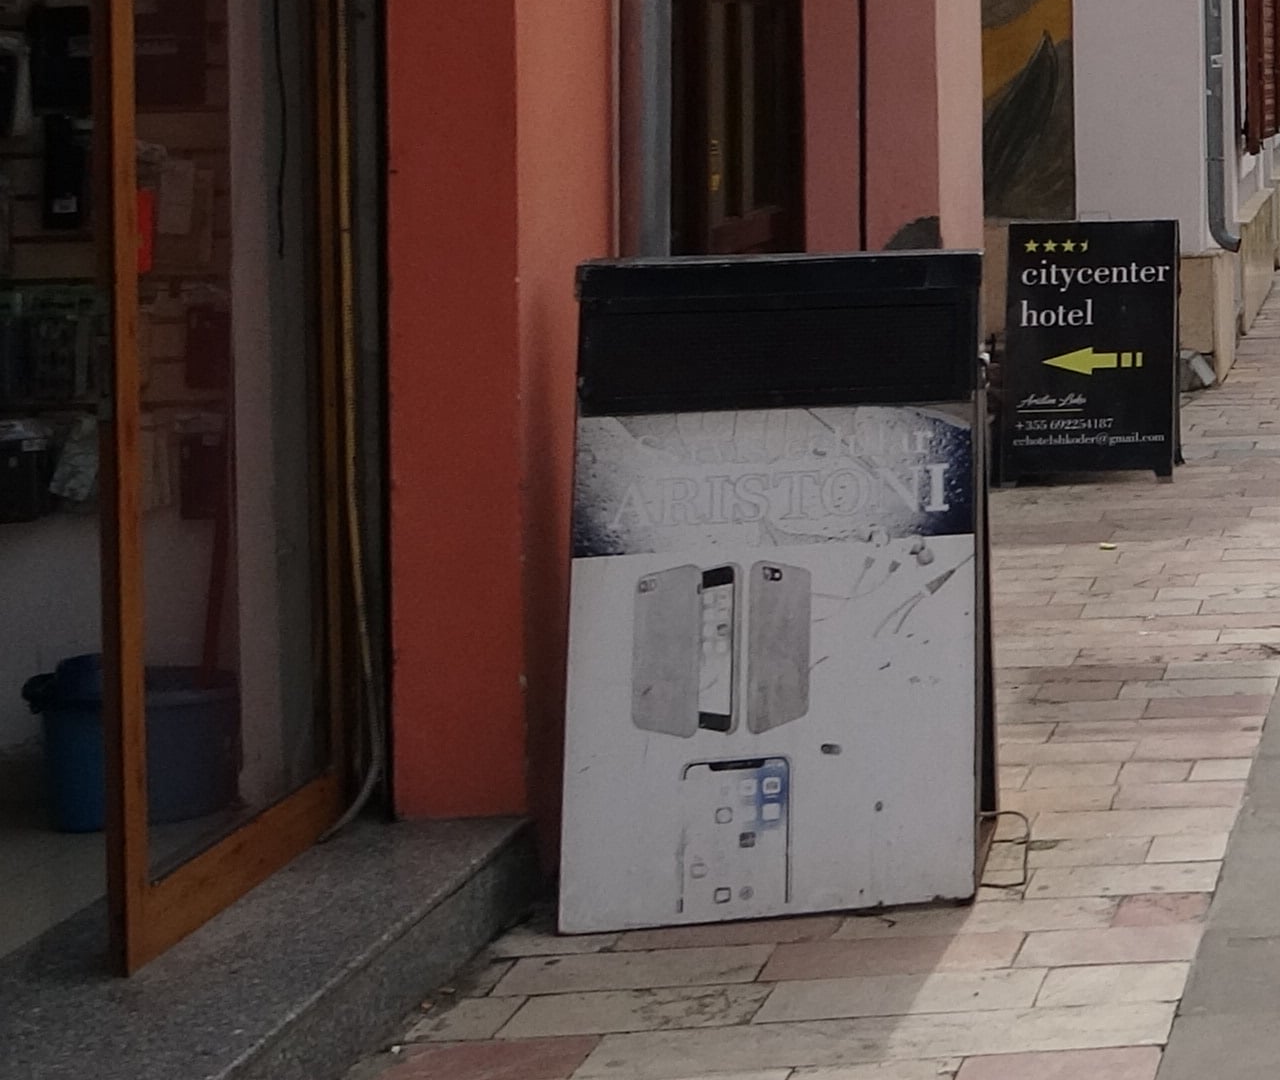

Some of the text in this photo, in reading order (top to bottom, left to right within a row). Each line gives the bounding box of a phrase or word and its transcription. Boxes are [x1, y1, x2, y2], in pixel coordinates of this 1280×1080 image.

[1021, 259, 1170, 292] citycenter
[1019, 298, 1095, 327] hotel
[606, 461, 951, 529] ARISTONI
